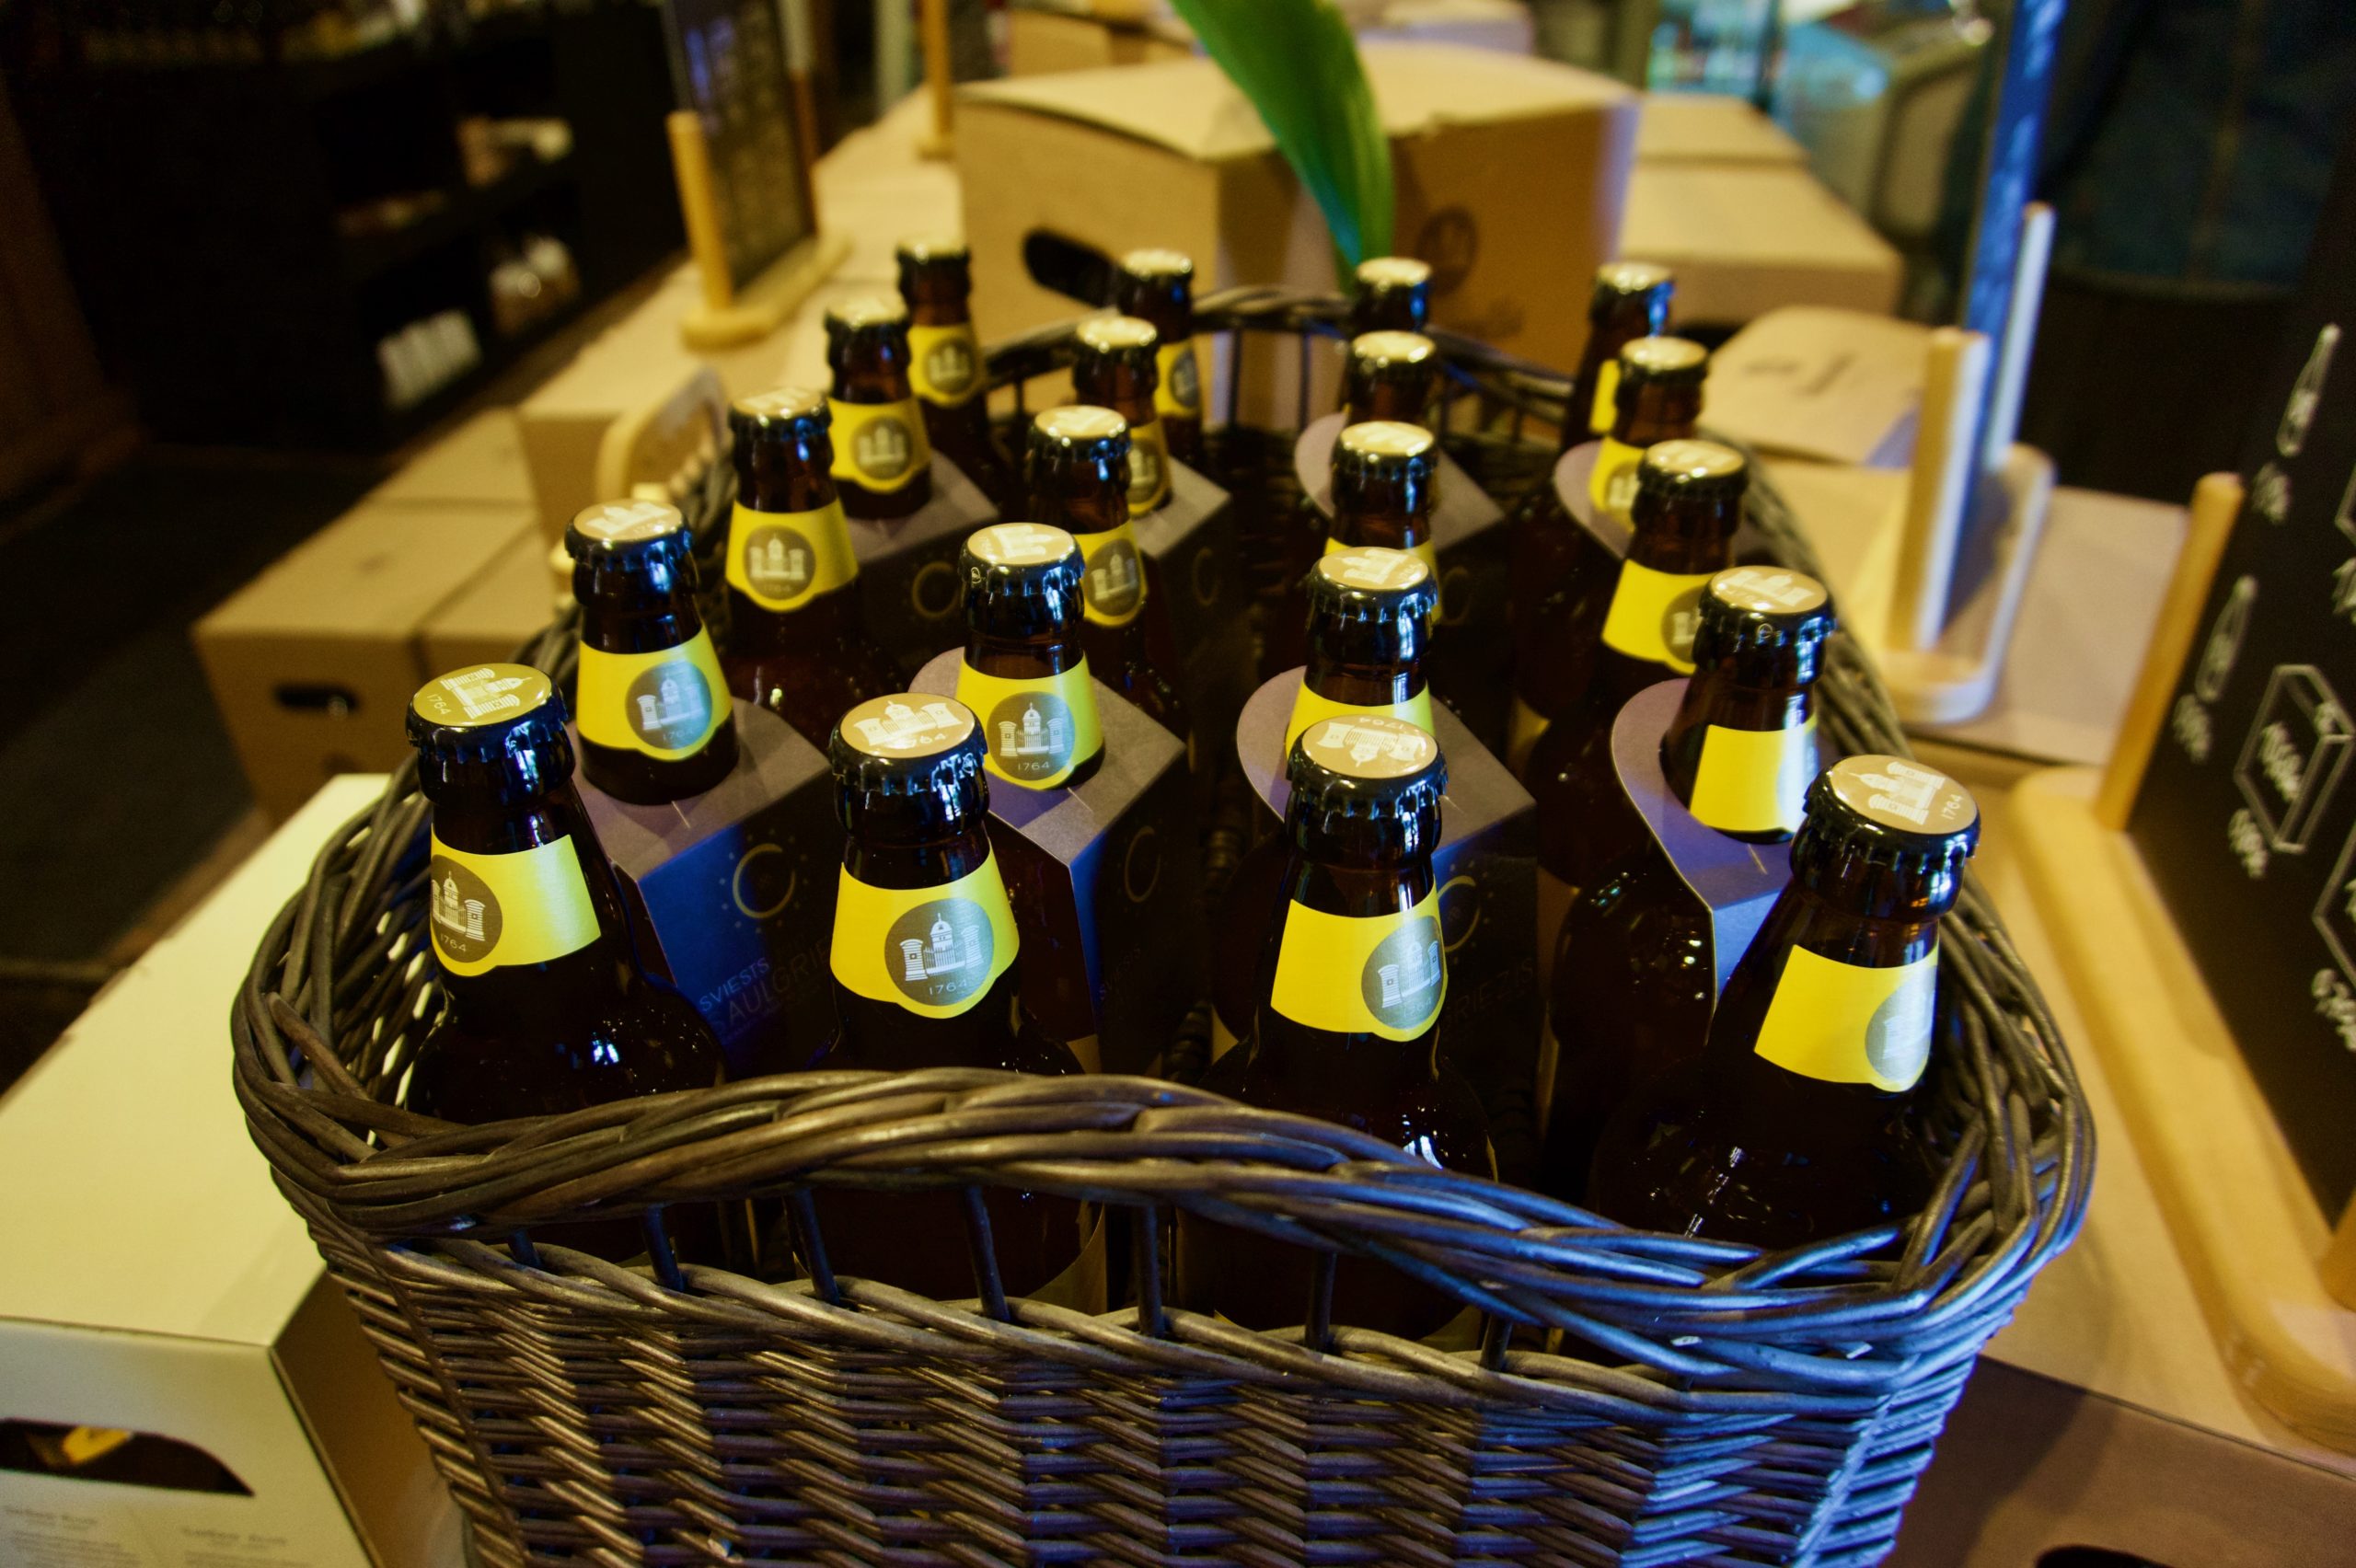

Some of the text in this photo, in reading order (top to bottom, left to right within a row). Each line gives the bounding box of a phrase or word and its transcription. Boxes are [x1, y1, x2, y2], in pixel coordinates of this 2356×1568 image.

[427, 694, 451, 715] 1764
[1359, 718, 1403, 730] 1764
[1017, 761, 1050, 771] 1764
[1942, 795, 1963, 820] 1764
[440, 933, 467, 951] 1764
[698, 956, 770, 1012] SVIESTS
[930, 980, 967, 996] 1764
